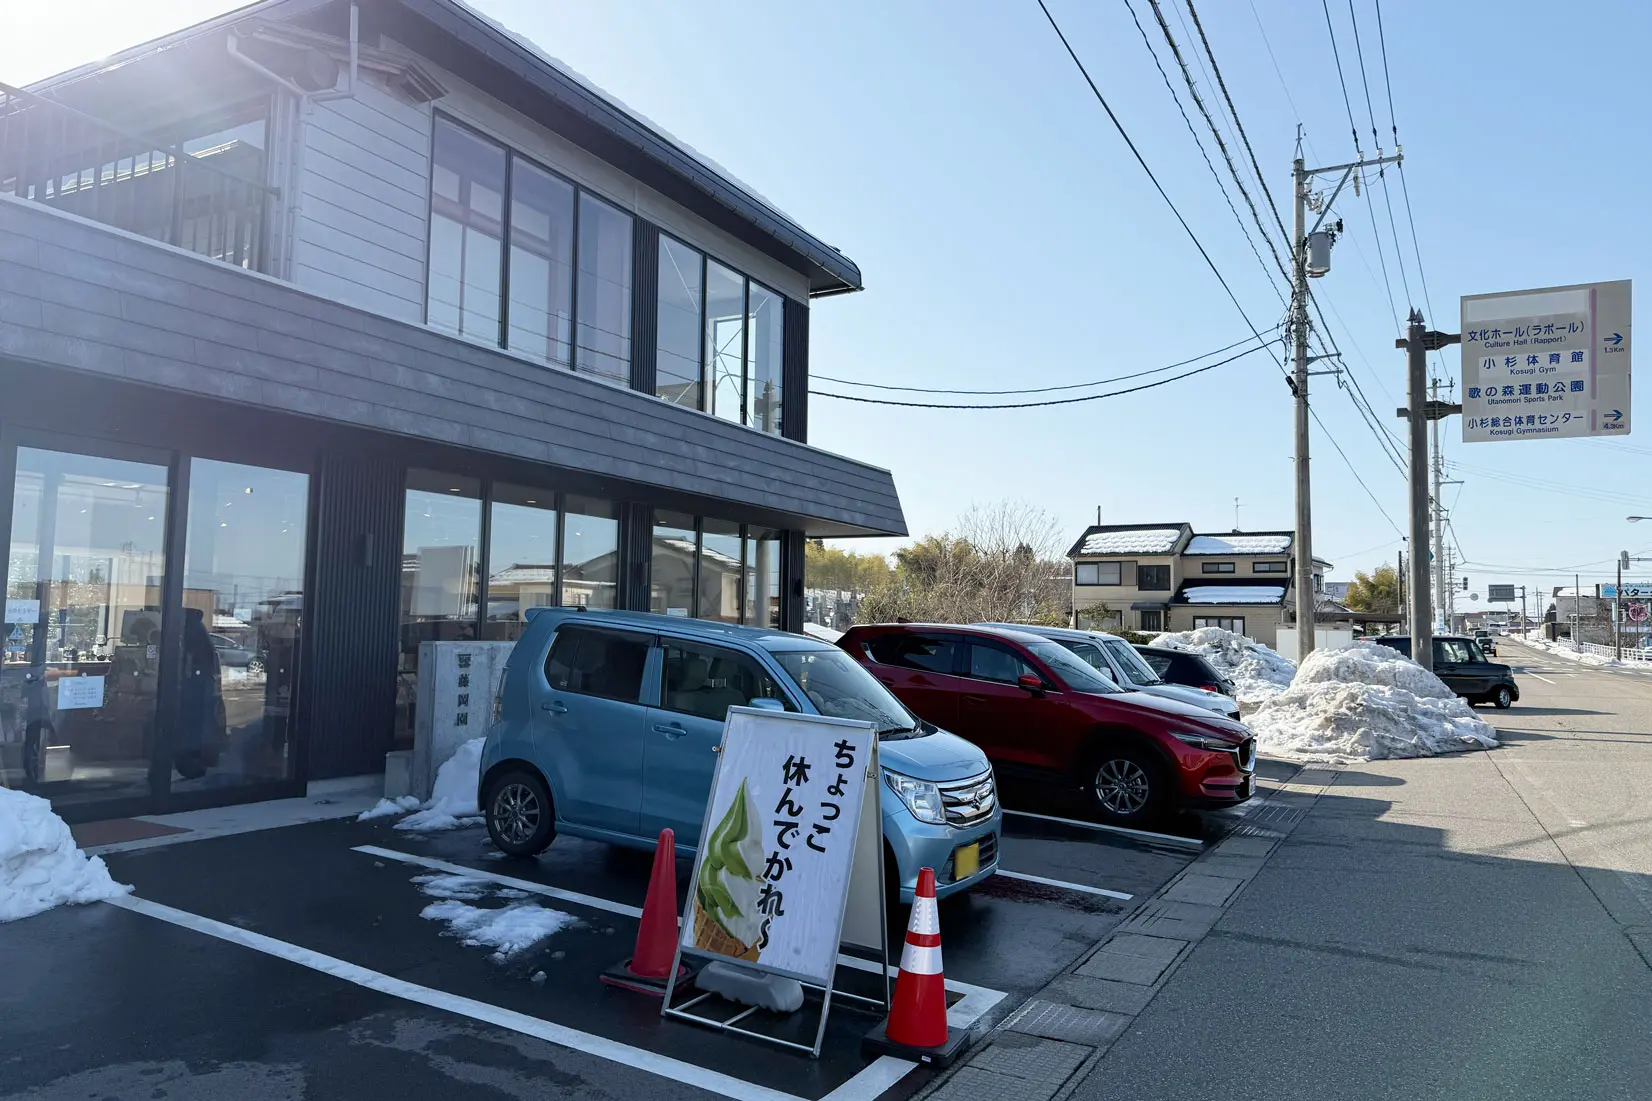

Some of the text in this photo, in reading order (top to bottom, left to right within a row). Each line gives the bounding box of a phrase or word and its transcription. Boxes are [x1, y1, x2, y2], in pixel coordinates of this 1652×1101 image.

[1484, 335, 1567, 349] Culture Hall (Rapport)
[1483, 351, 1584, 370] 小杉体育館
[1510, 366, 1557, 376] Kosugi Gym
[1468, 380, 1584, 399] 歌の森運動公園
[1487, 394, 1564, 406] Utanomori Sports Park
[1467, 412, 1584, 429] 小杉総合体育センター
[1489, 426, 1559, 436] Kosugi Gymnasium
[805, 739, 856, 853] ちょっこ
